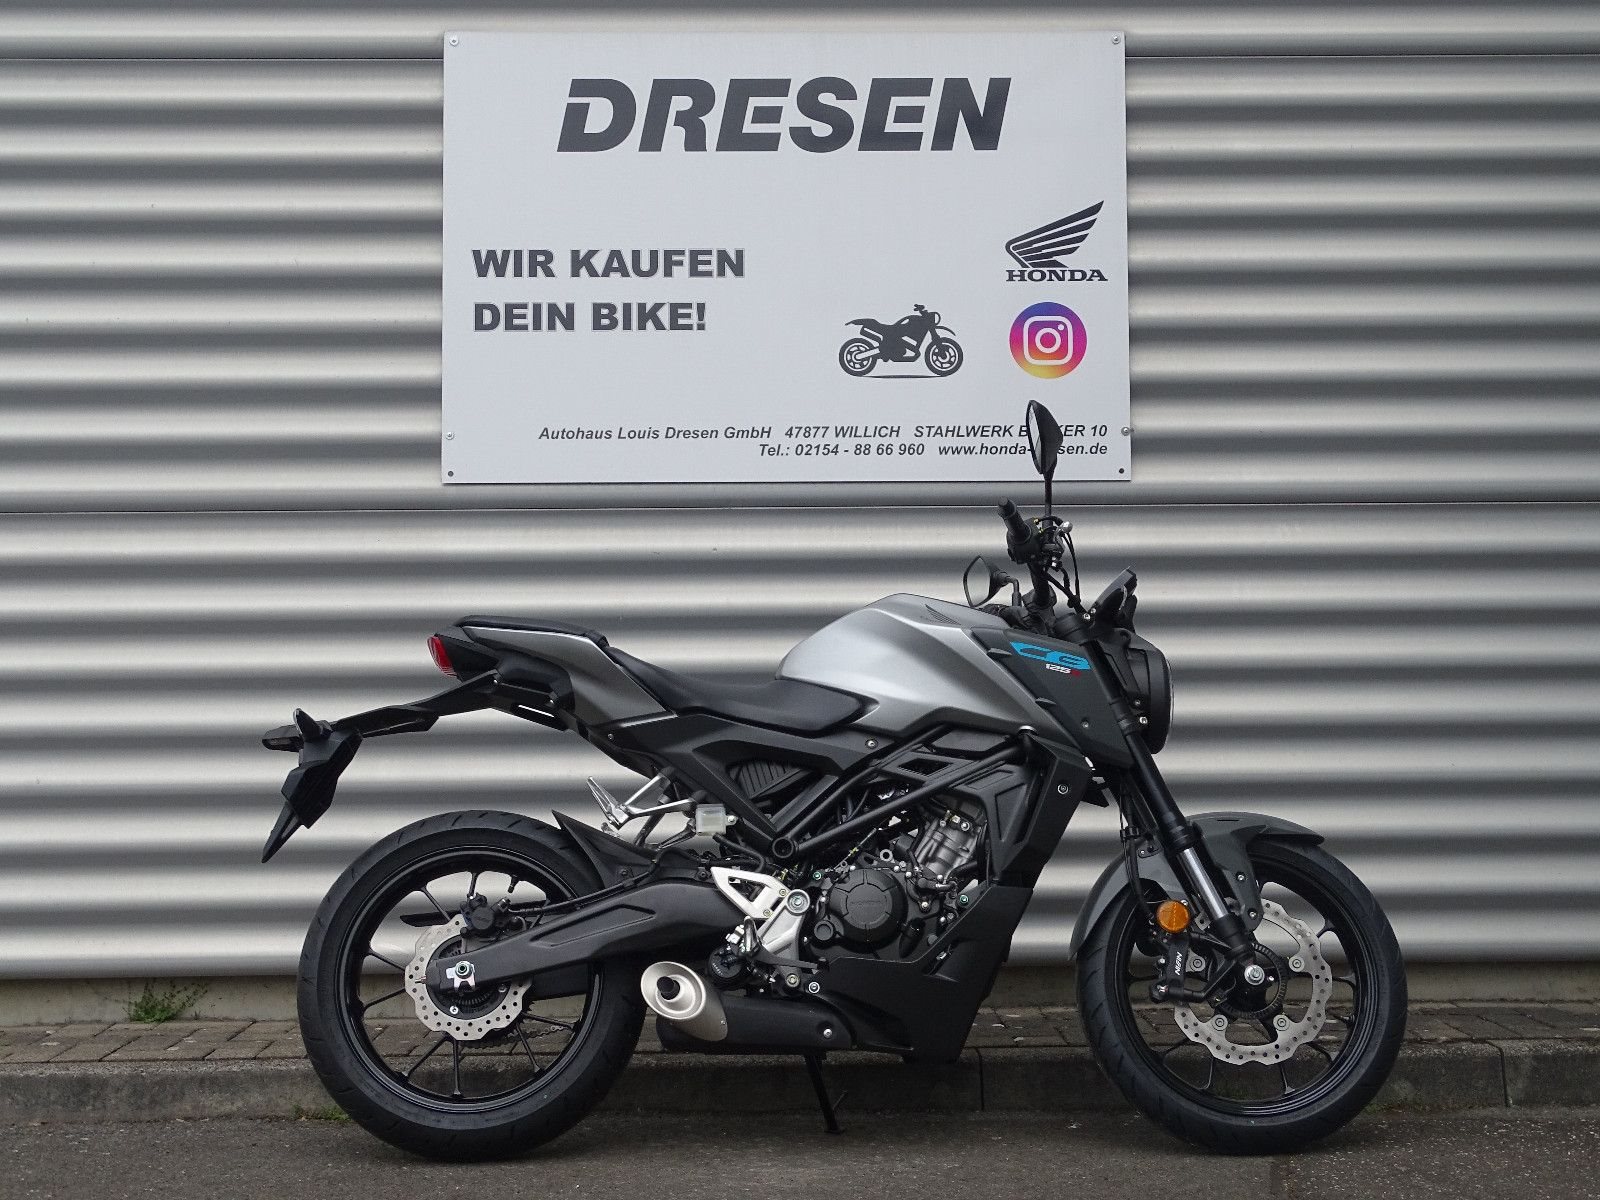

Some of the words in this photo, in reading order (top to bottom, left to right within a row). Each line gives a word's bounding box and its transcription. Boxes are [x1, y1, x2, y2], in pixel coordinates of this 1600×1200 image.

[557, 76, 1011, 153] DRESEN
[472, 249, 555, 278] WIR
[570, 249, 744, 278] KAUFEN
[1006, 269, 1108, 282] HONDA
[474, 302, 575, 332] DEIN
[592, 301, 706, 331] BIKE!
[538, 426, 613, 440] Autohaus
[617, 426, 660, 440] Louis
[664, 426, 719, 439] Dresen
[723, 426, 772, 439] GmbH
[784, 425, 830, 438] 47877
[834, 425, 901, 438] WILLICH
[913, 424, 1014, 438] STAHLWERK
[1018, 424, 1086, 438] BER
[1091, 424, 1108, 437] 10
[759, 443, 790, 456] Tel.:
[794, 443, 840, 456] 02154
[853, 443, 871, 456] 88
[876, 443, 894, 456] 66
[898, 443, 925, 456] 960
[938, 442, 1108, 456] www.honda-sen.de
